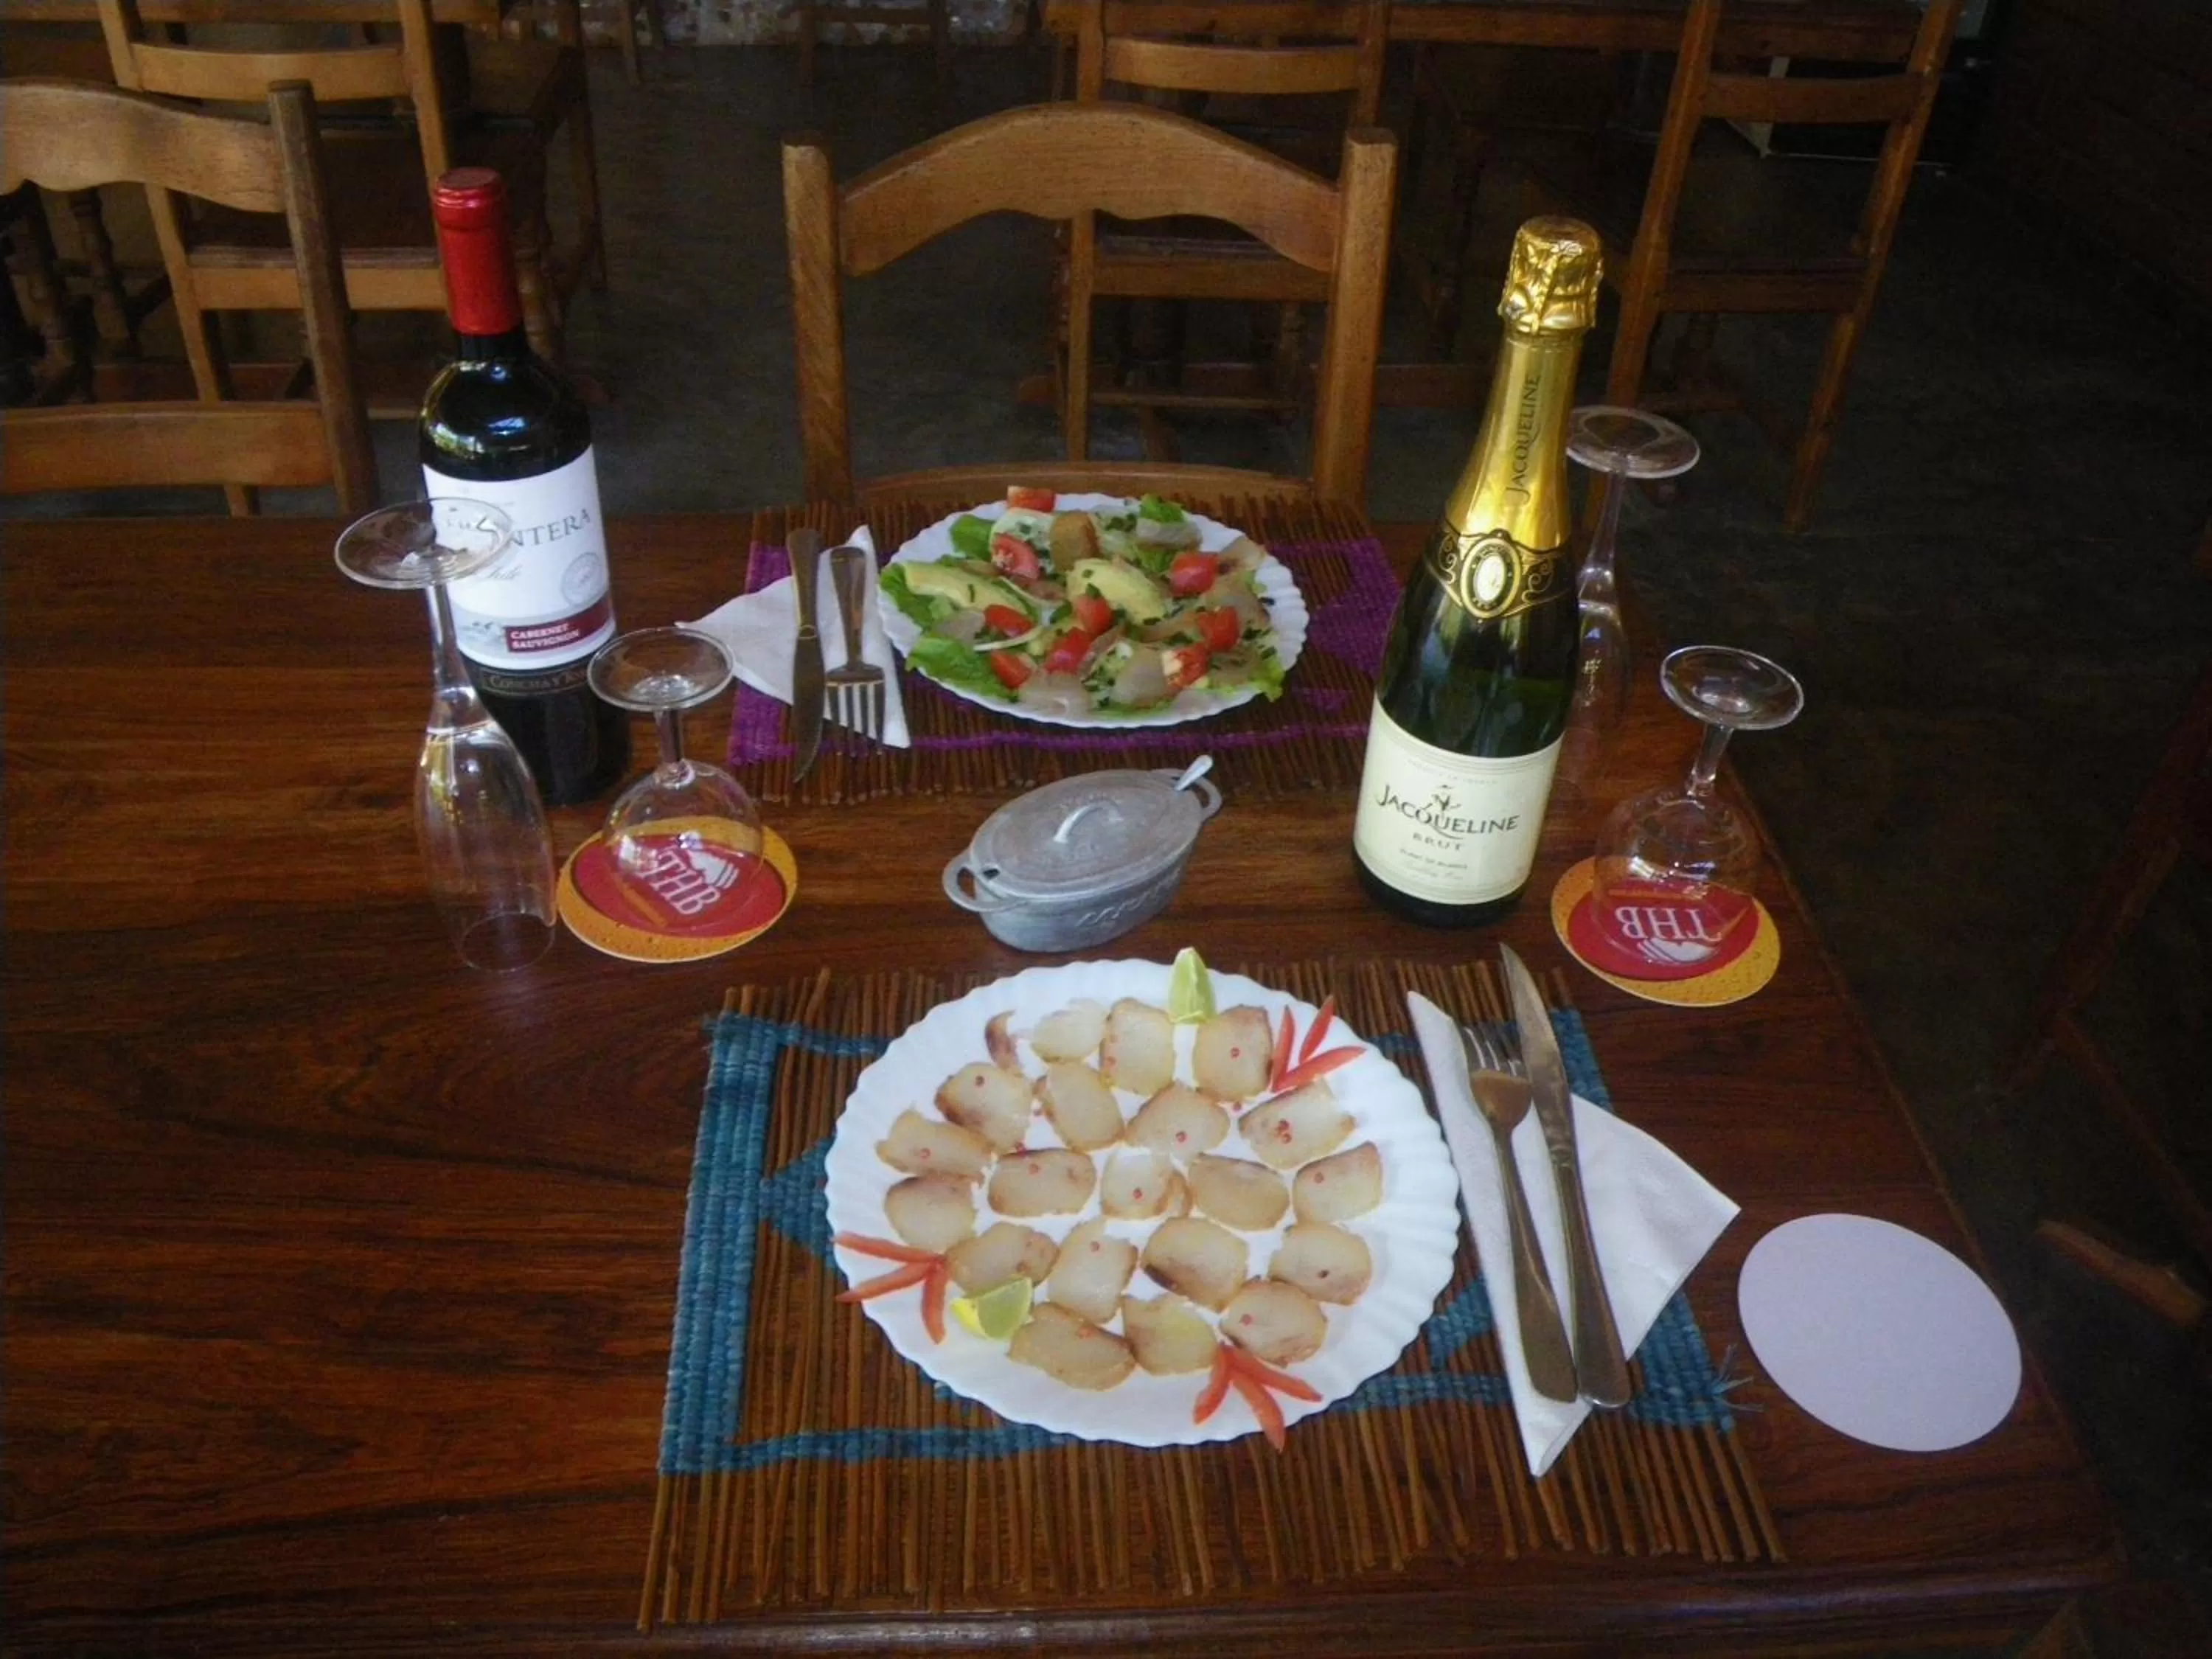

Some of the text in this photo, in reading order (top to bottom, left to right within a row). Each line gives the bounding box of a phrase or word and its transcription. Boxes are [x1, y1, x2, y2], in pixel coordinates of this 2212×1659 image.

[1506, 375, 1540, 504] JACQUELINE
[1375, 784, 1520, 839] JACQUELINE
[1413, 832, 1464, 851] BRUT
[636, 849, 720, 914] THB
[1614, 906, 1722, 942] THB
